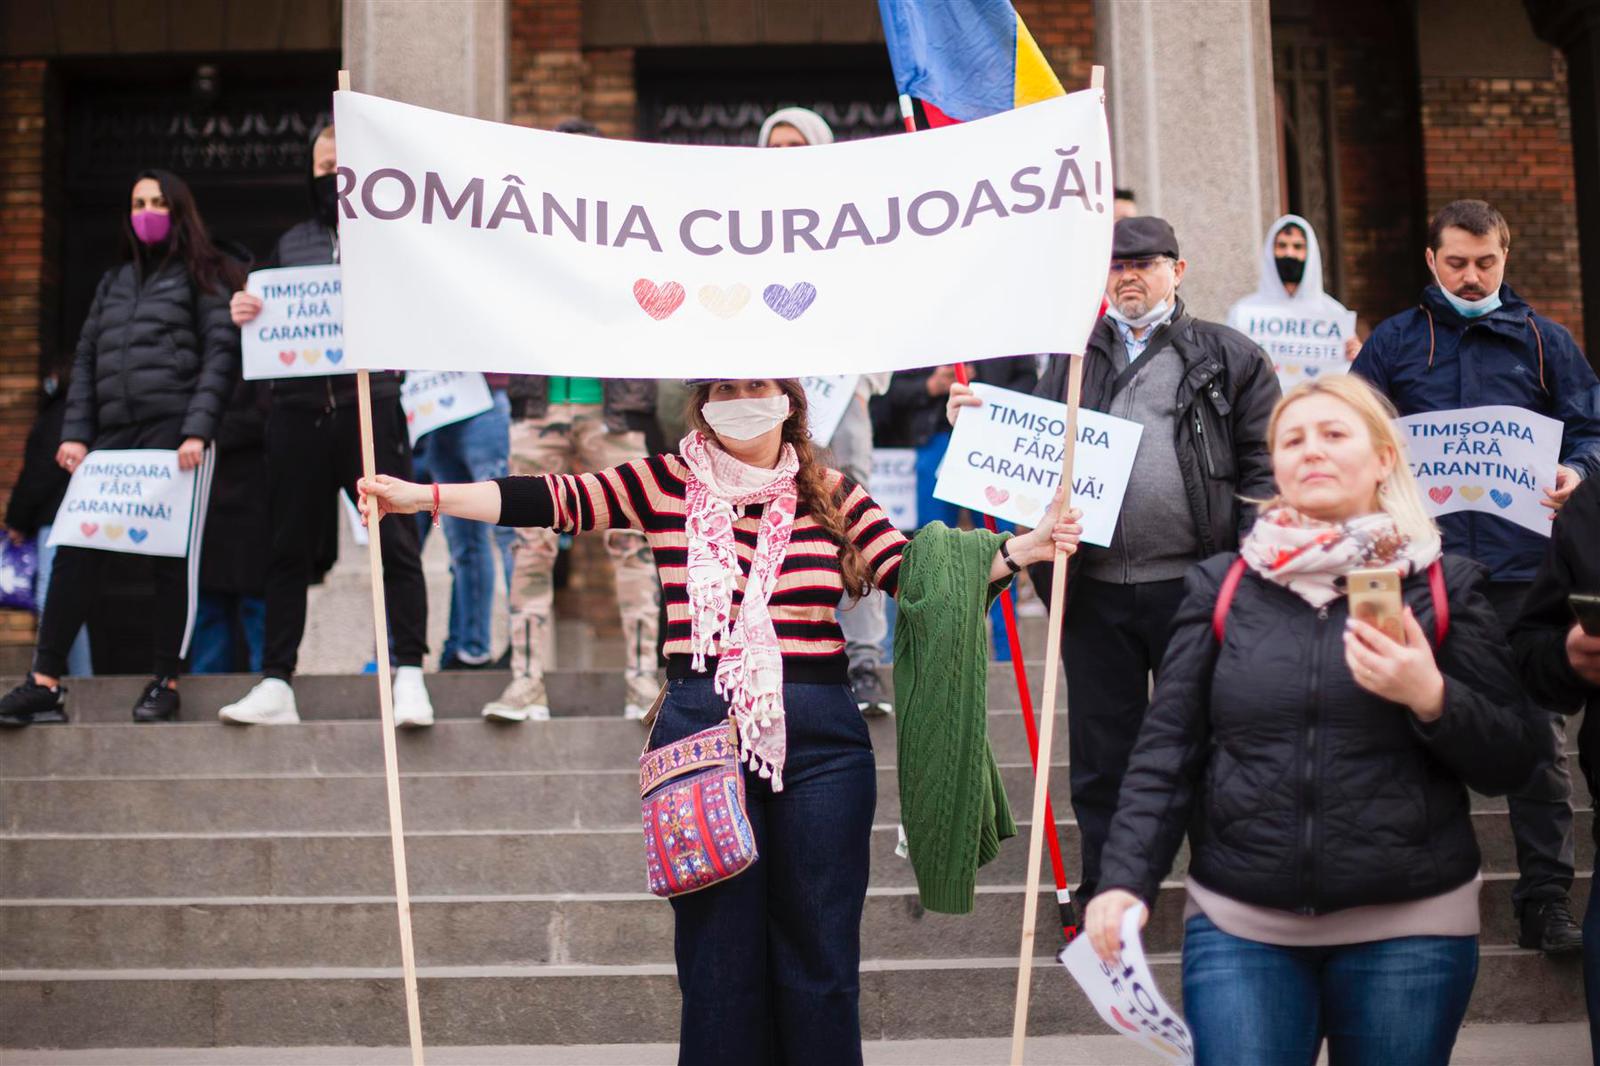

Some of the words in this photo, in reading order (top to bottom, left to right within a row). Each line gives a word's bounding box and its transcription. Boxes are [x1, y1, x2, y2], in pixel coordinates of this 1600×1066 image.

[336, 166, 664, 254] ROMÂNIA
[680, 145, 1104, 256] CURAJOASĂ!
[1250, 318, 1341, 337] HORECA
[1409, 421, 1534, 444] TIMIȘOARA
[1443, 438, 1503, 456] FĂRĂ
[67, 499, 172, 520] CARANTINĂ!
